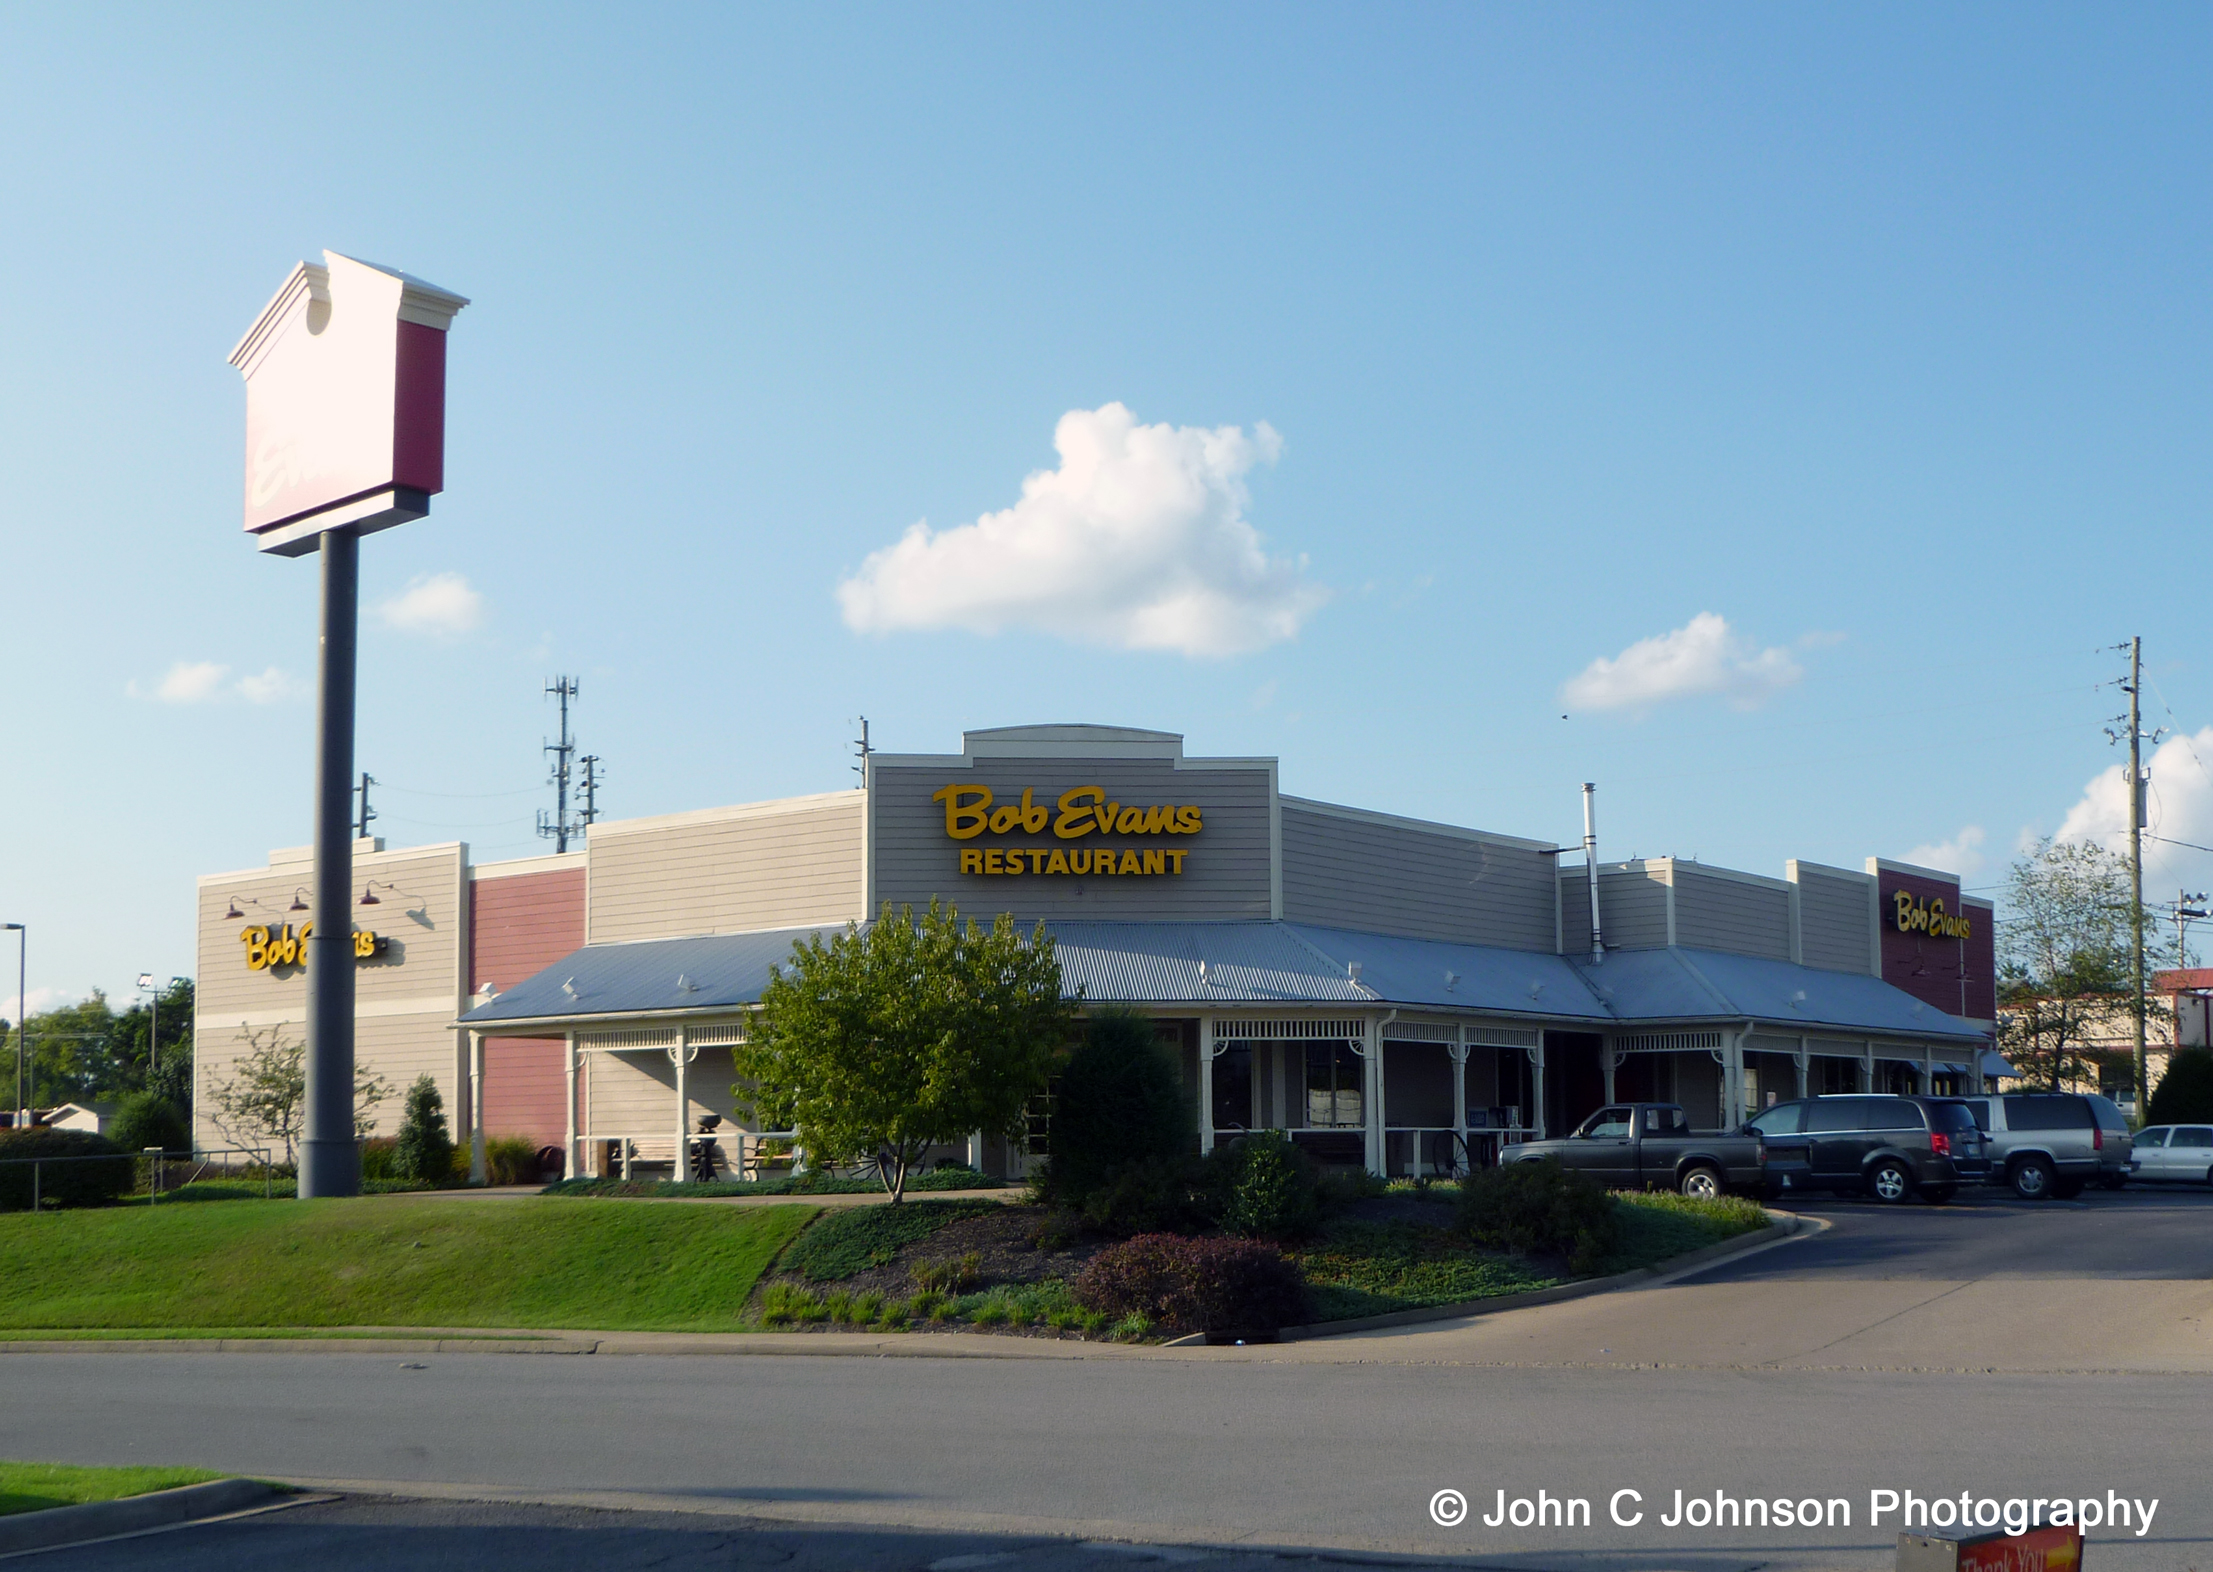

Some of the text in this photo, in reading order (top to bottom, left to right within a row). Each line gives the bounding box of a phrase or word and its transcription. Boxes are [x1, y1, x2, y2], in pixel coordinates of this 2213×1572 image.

[932, 783, 1203, 840] Bob Evans
[960, 848, 1189, 875] RESTAURANT
[1893, 889, 1971, 939] Bob Evans
[239, 924, 297, 971] Bob
